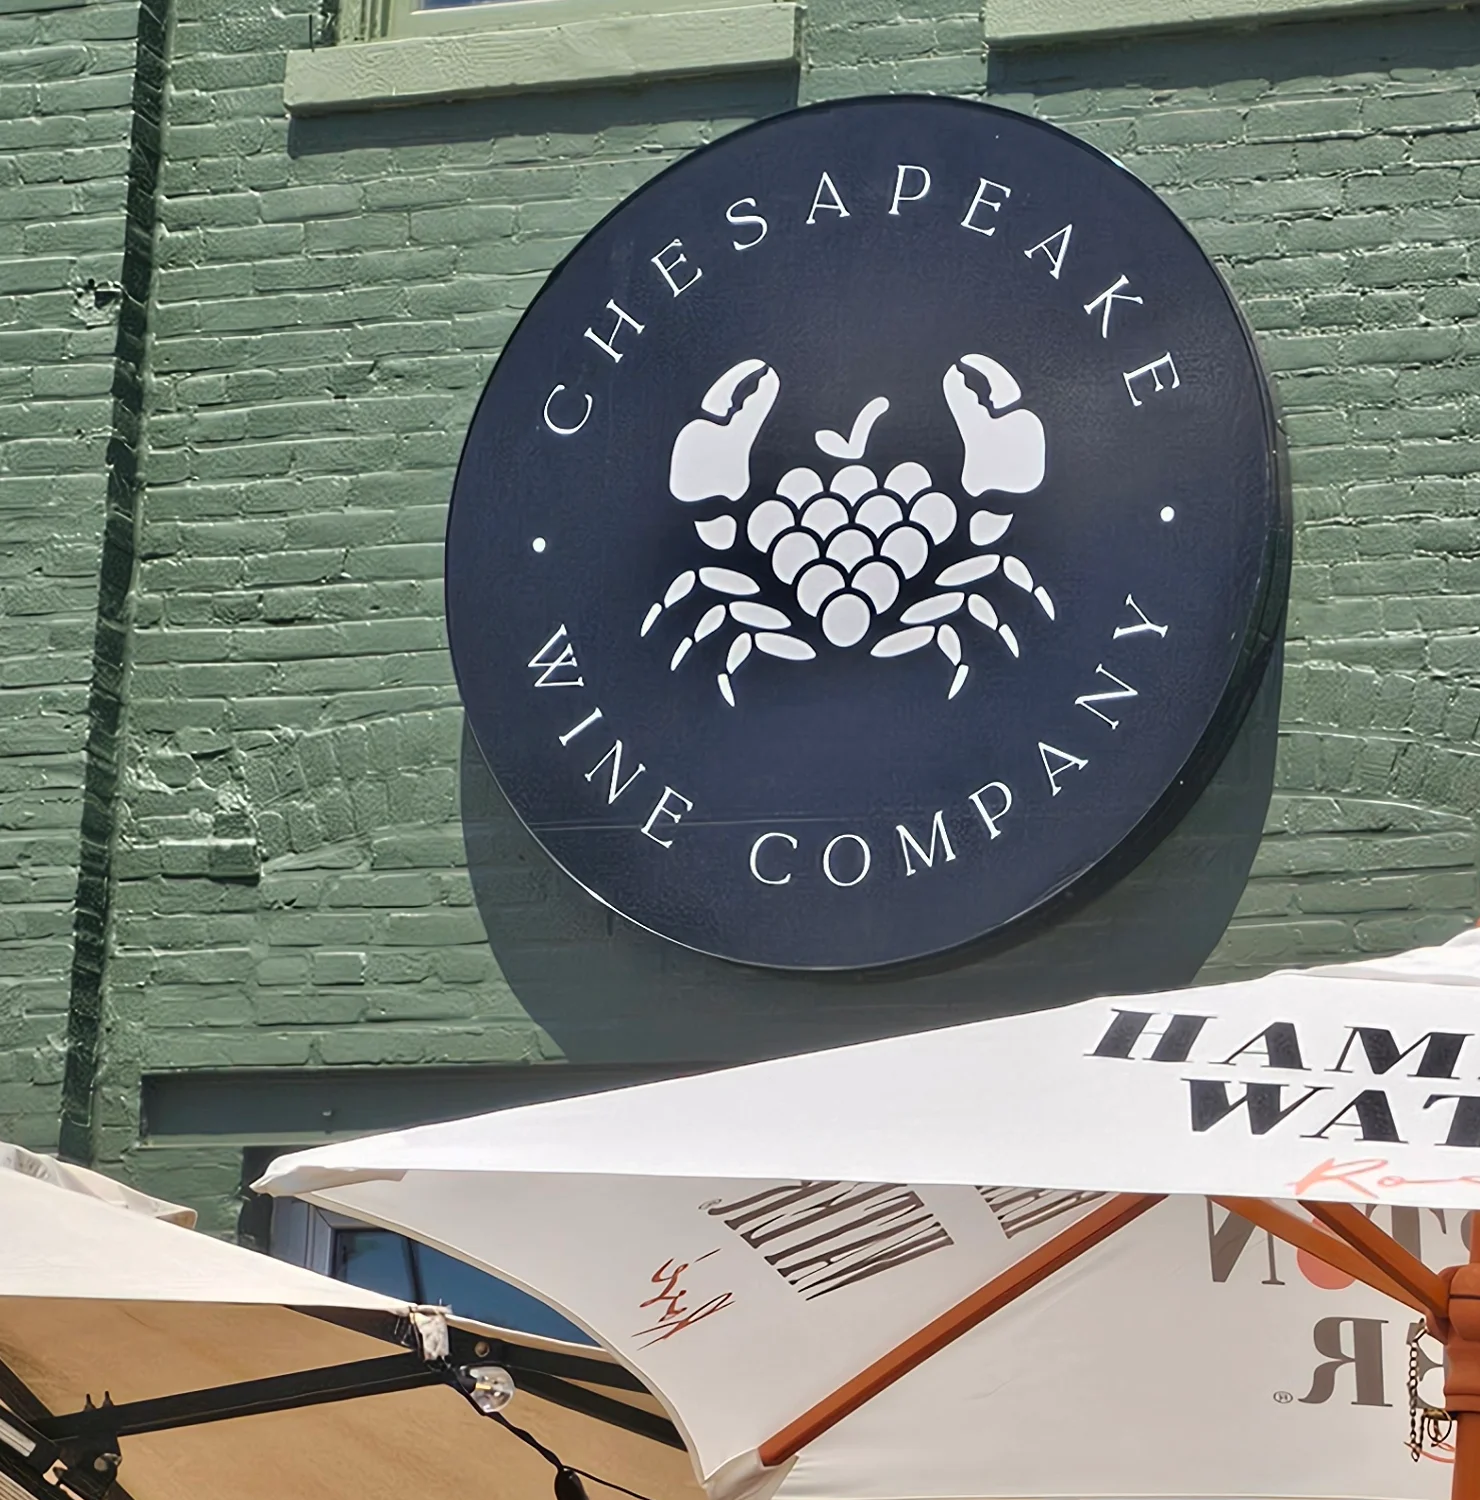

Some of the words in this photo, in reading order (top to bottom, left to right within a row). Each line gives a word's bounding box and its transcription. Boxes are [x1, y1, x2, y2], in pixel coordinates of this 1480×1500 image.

[542, 163, 1182, 436] CHESAPEAKE
[527, 623, 694, 849] WINE
[748, 594, 1169, 888] COMPANY
